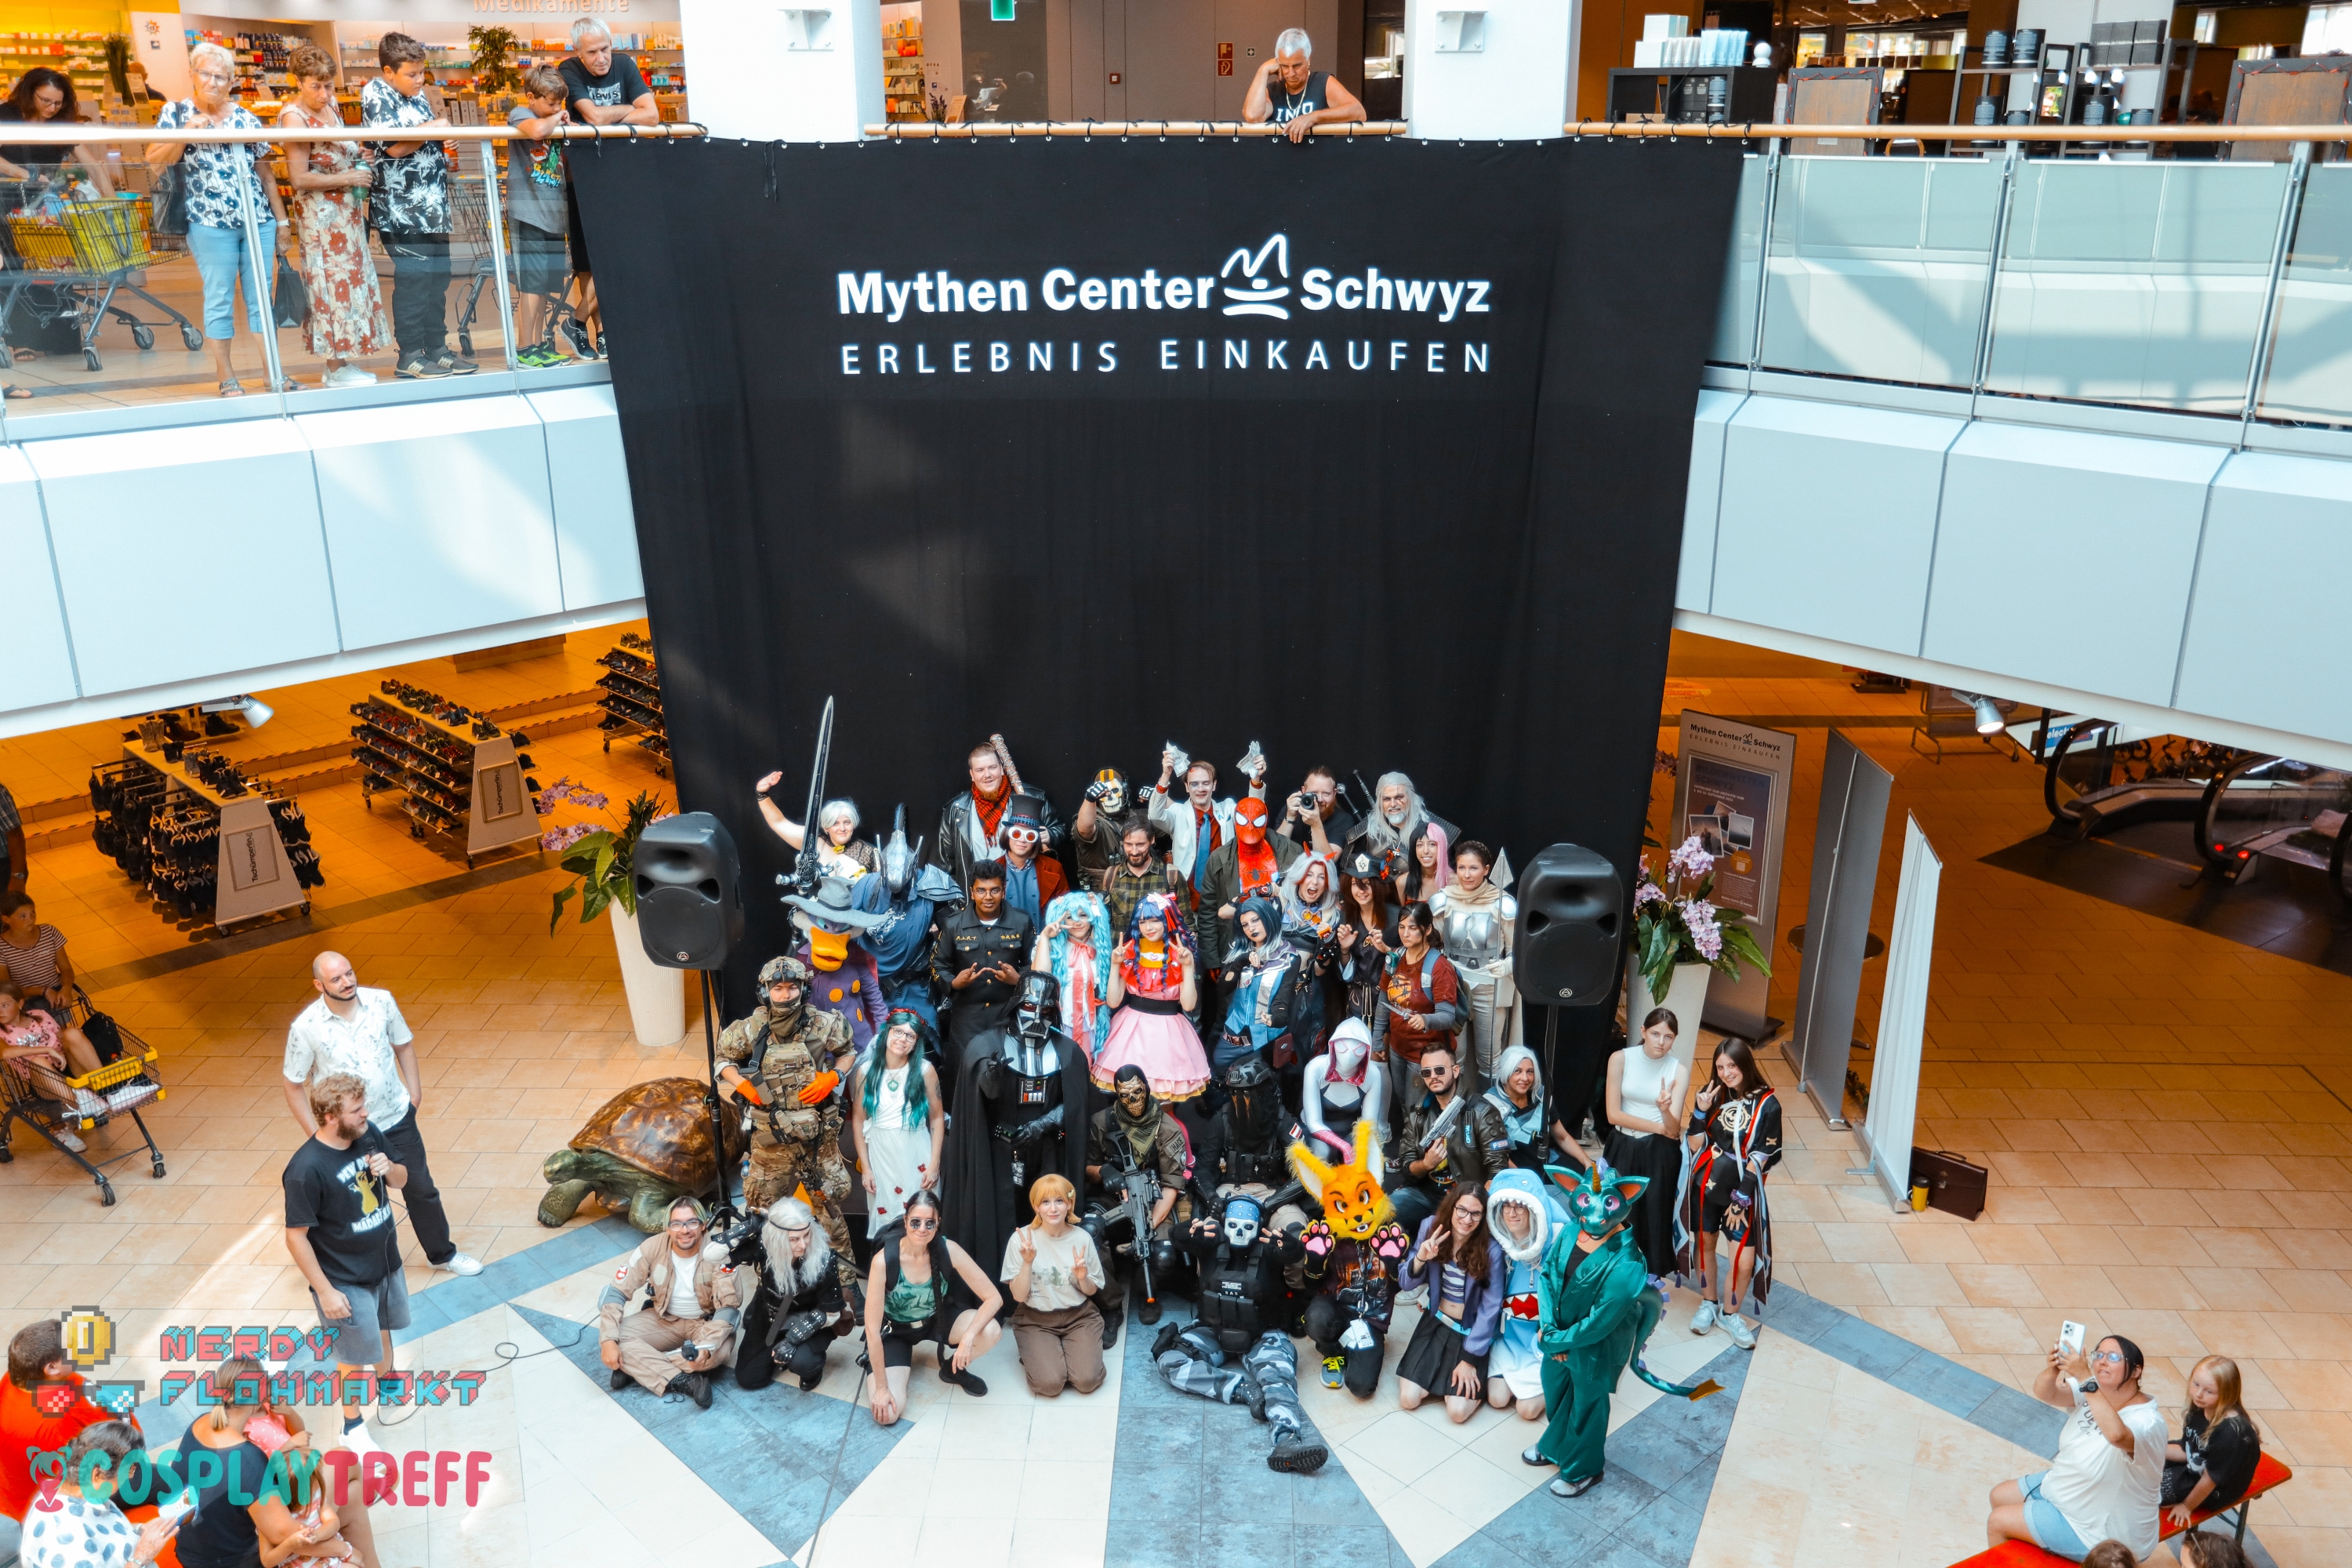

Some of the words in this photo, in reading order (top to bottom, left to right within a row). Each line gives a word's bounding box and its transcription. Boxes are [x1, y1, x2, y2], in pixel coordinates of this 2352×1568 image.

[838, 271, 1027, 322] Mythen
[1043, 269, 1214, 310] Center
[1301, 268, 1489, 322] Schwyz
[842, 343, 1116, 374] ERLEBNIS
[1161, 340, 1486, 372] EINKAUFEN
[1690, 724, 1716, 736] Mythen
[1718, 730, 1742, 742] Center
[1754, 739, 1780, 752] Schwyz
[1690, 734, 1728, 748] ERLEBNIS
[1733, 744, 1780, 760] EINKAUFEN
[2047, 726, 2070, 739] elect
[495, 774, 503, 815] Tschümperlin
[246, 837, 258, 882] Tschümperlin
